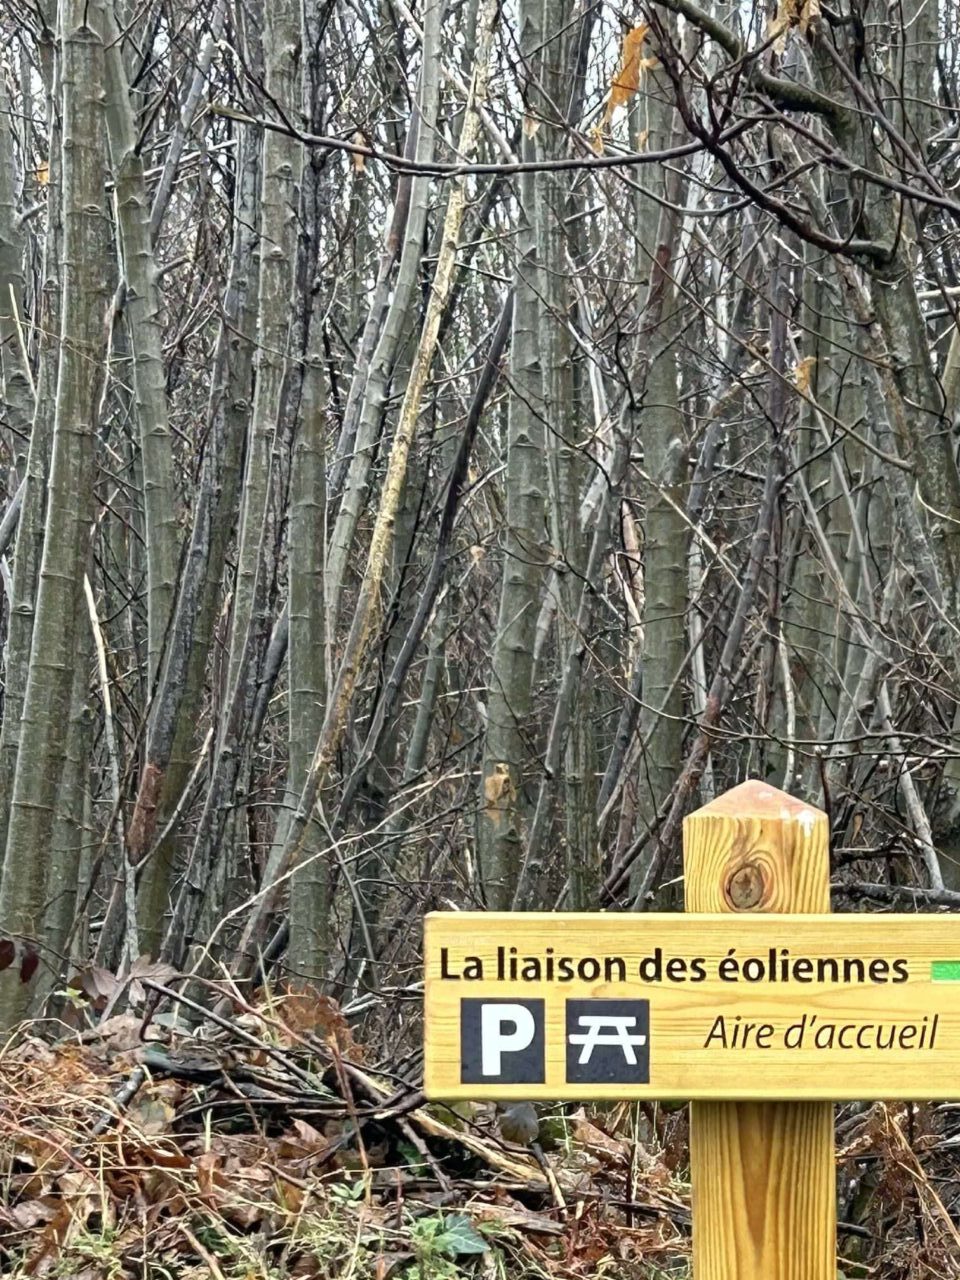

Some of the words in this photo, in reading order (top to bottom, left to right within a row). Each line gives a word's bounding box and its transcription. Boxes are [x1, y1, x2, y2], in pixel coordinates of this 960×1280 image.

[440, 947, 483, 980] La
[497, 946, 626, 982] liaison
[639, 947, 707, 982] des
[718, 947, 909, 983] éoliennes
[480, 1003, 536, 1077] P
[703, 1015, 775, 1049] Aire
[784, 1014, 939, 1049] d'accueil
